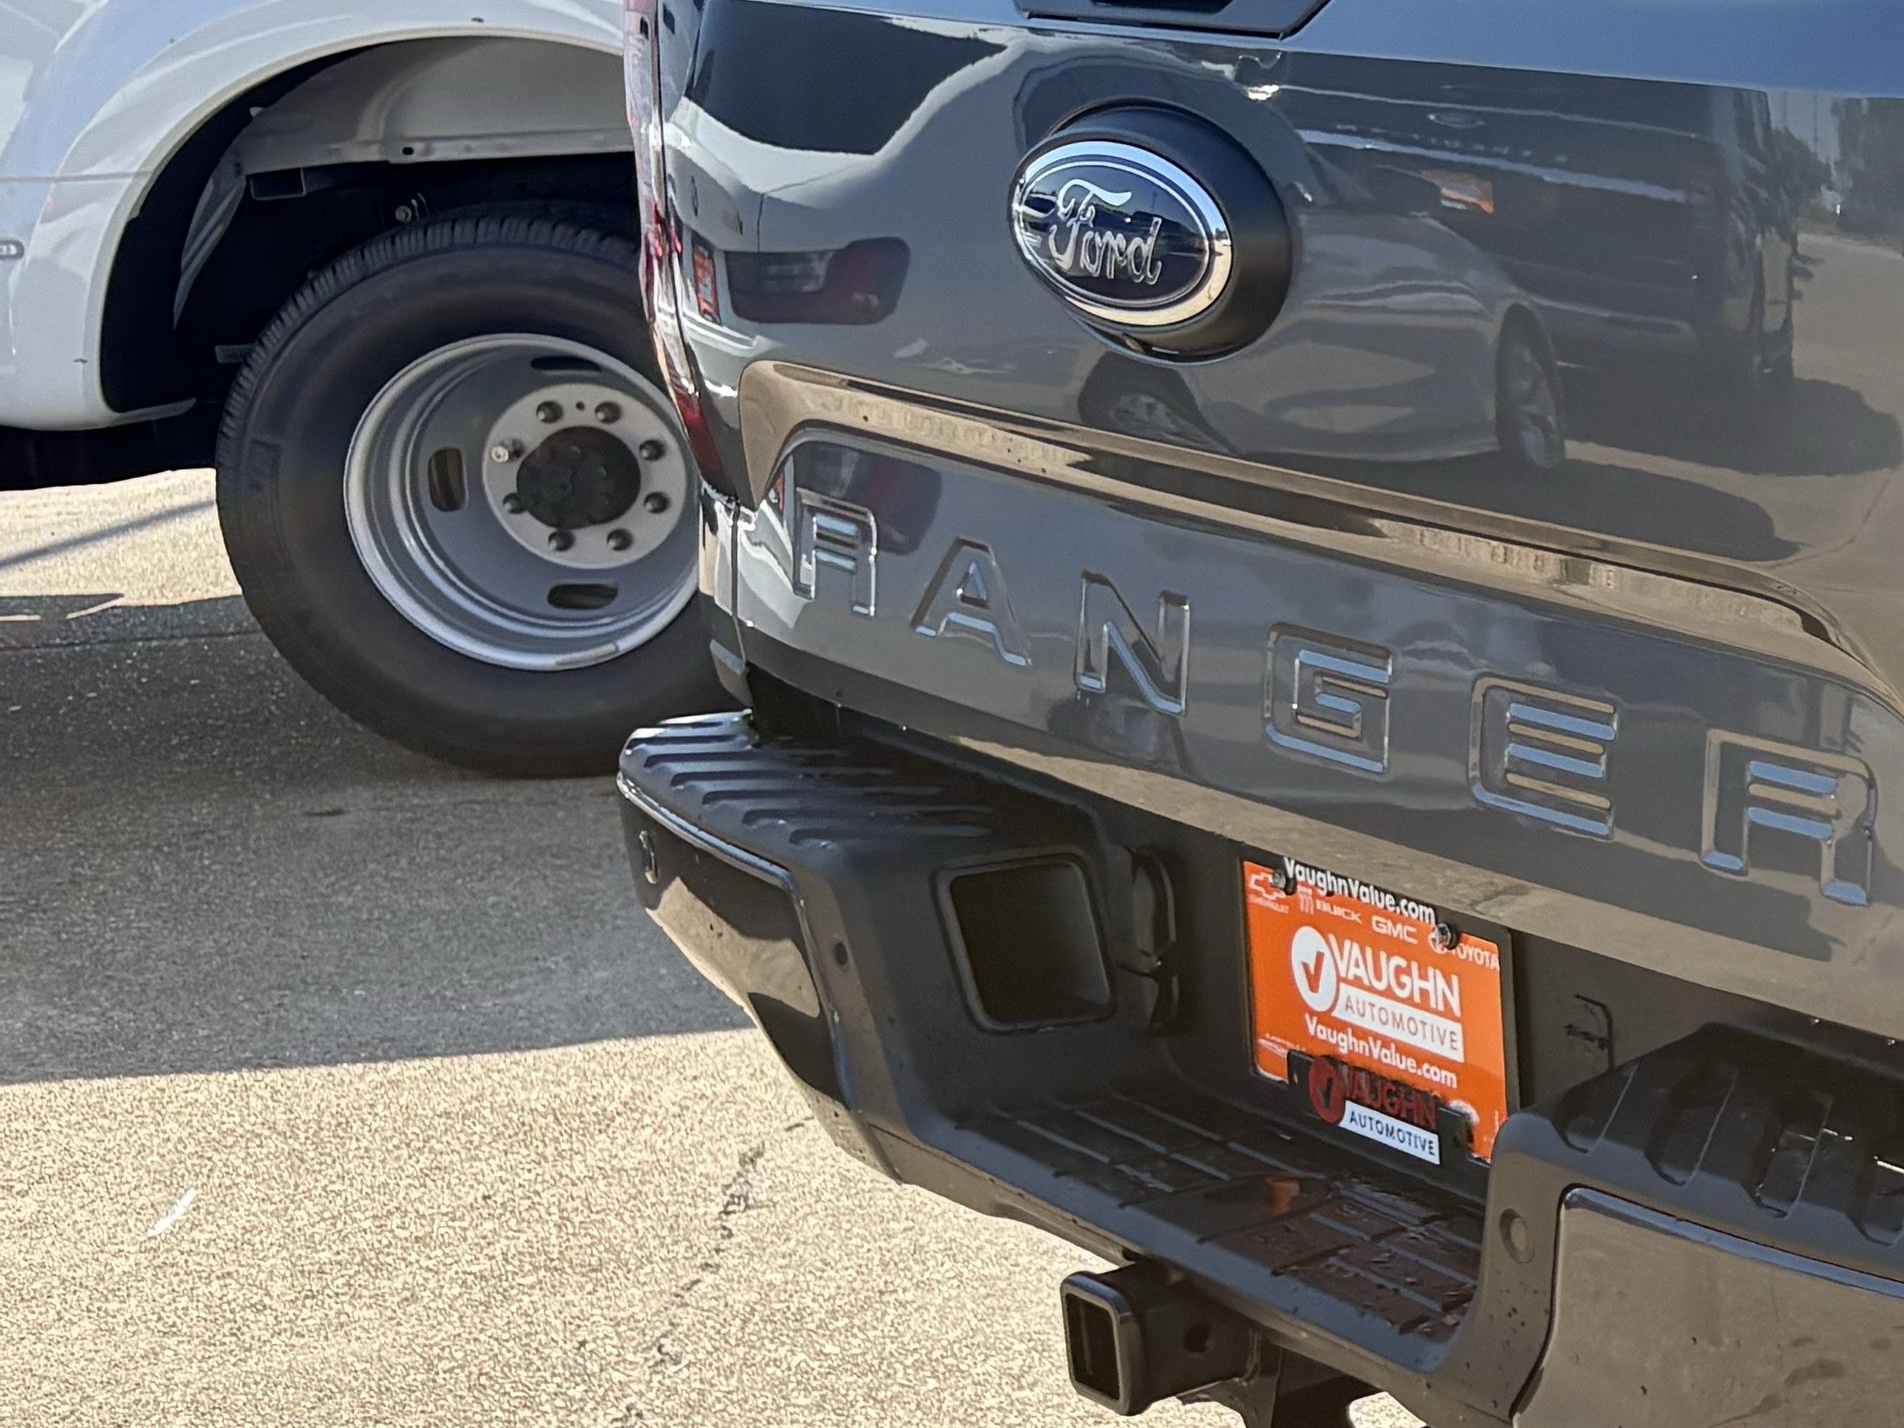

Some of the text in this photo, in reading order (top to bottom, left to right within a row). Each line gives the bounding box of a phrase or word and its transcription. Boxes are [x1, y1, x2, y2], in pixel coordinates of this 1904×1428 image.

[1048, 178, 1163, 285] Ford
[796, 486, 1876, 906] RANGER
[1283, 857, 1436, 925] VaughnValue.com
[1315, 899, 1363, 924] BUICK
[1371, 915, 1418, 945] GMC
[1328, 932, 1462, 1018] VAUGHN
[1305, 1013, 1458, 1090] VaughnValue.com
[1344, 995, 1459, 1052] AUTOMOTIVE
[1341, 1064, 1439, 1130] VAUGHN
[1348, 1109, 1437, 1156] AUTOMOTIVE
